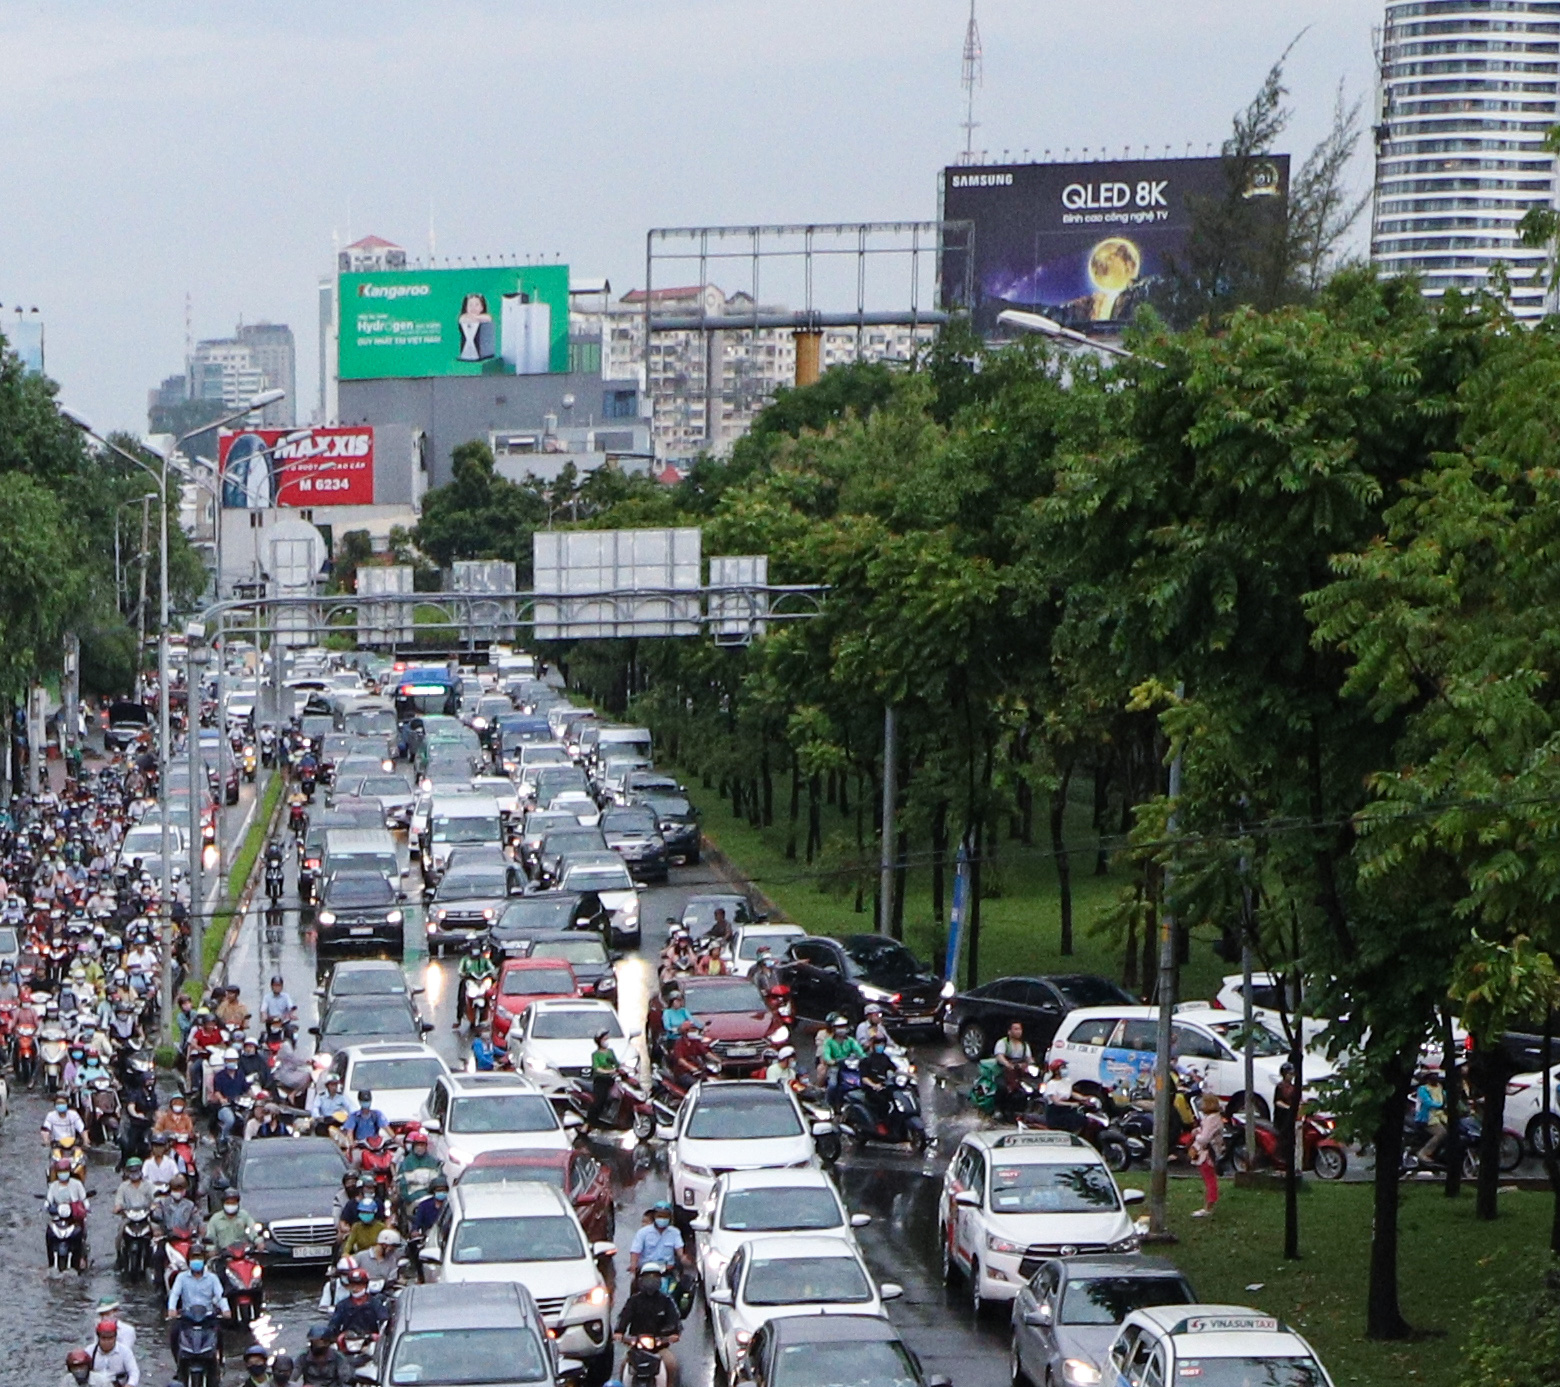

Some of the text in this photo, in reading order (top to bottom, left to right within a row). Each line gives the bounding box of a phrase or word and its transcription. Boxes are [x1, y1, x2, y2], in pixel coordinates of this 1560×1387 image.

[952, 173, 1013, 188] SAMSUNG
[1062, 180, 1169, 211] QLED 8K
[1085, 213, 1103, 223] cao
[1104, 211, 1129, 224] công
[1130, 210, 1154, 224] nghệ
[1156, 210, 1168, 220] TV
[358, 284, 430, 299] Kangaroo
[357, 320, 414, 335] Hydrogen
[274, 434, 369, 459] MAXXIS
[300, 478, 350, 492] M 6234
